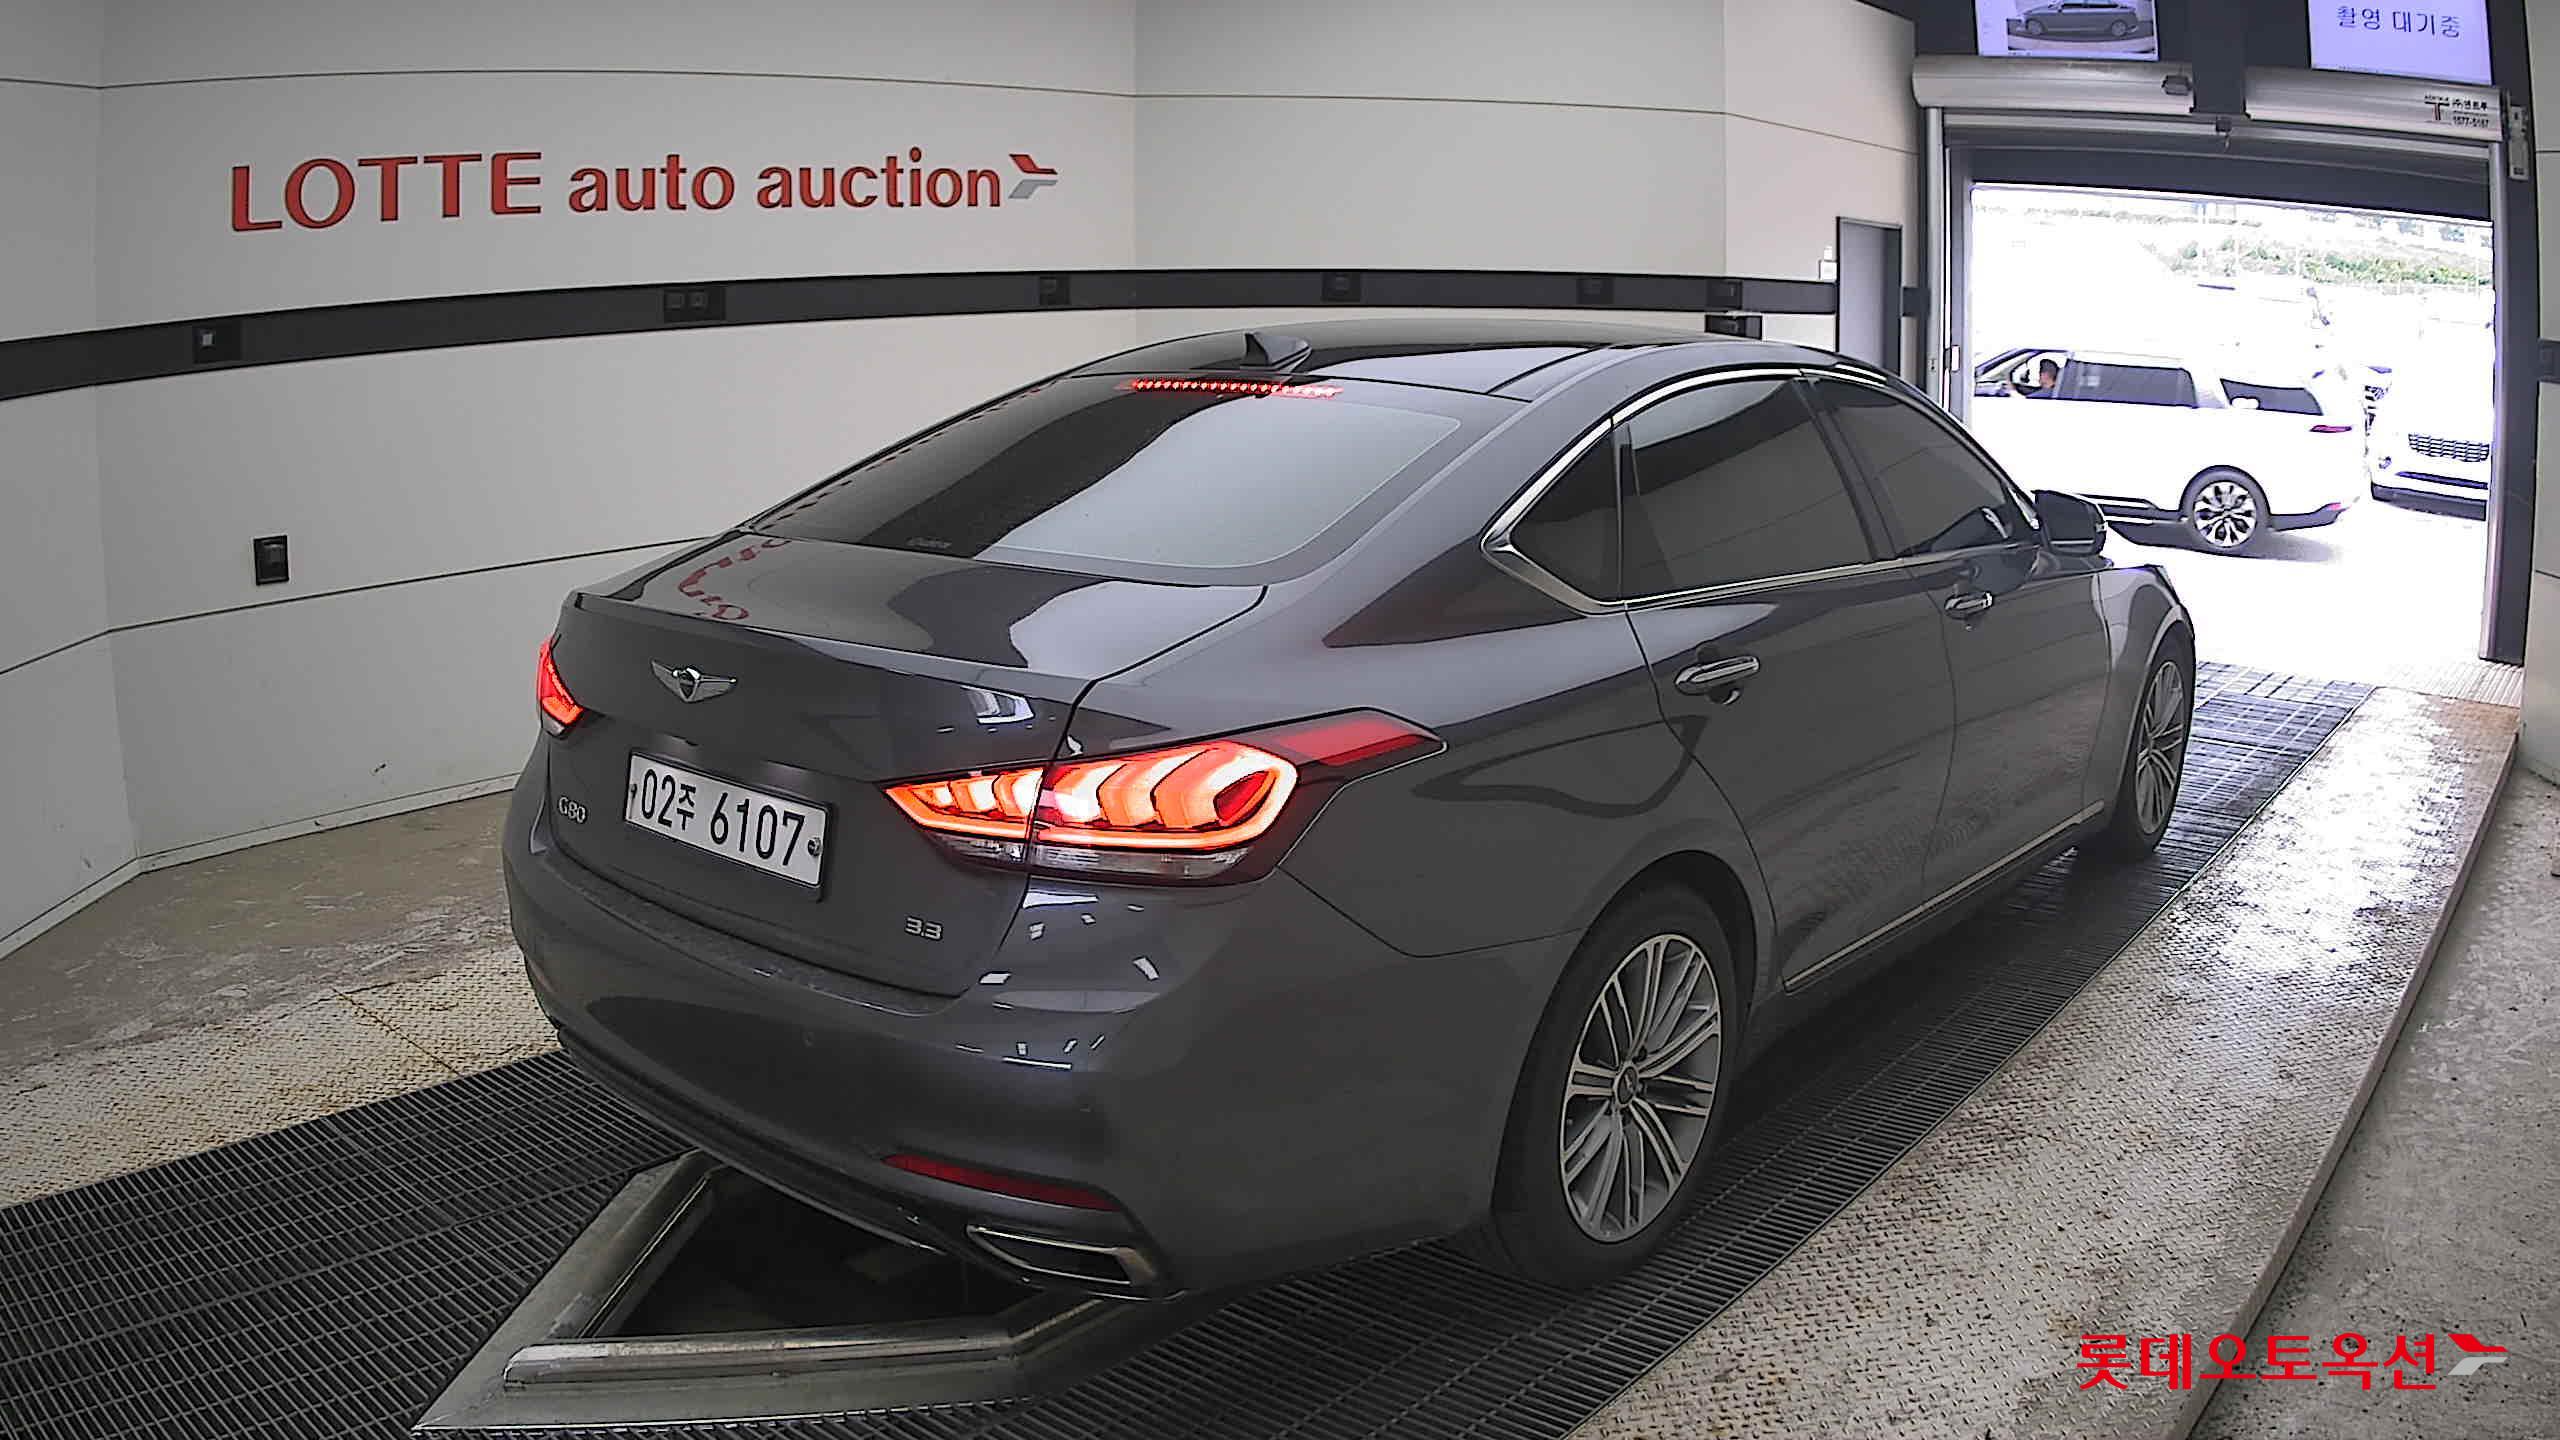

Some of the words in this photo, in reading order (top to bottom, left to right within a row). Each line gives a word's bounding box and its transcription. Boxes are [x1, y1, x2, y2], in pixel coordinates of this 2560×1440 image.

[2337, 5, 2381, 31] 촬영
[2392, 10, 2460, 38] 대기중
[231, 151, 542, 232] LOTTE
[568, 153, 736, 212] auto
[756, 146, 1002, 209] auction
[558, 796, 586, 824] G80
[641, 768, 697, 831] 02주
[710, 792, 805, 866] 6107
[905, 916, 942, 940] 3.3
